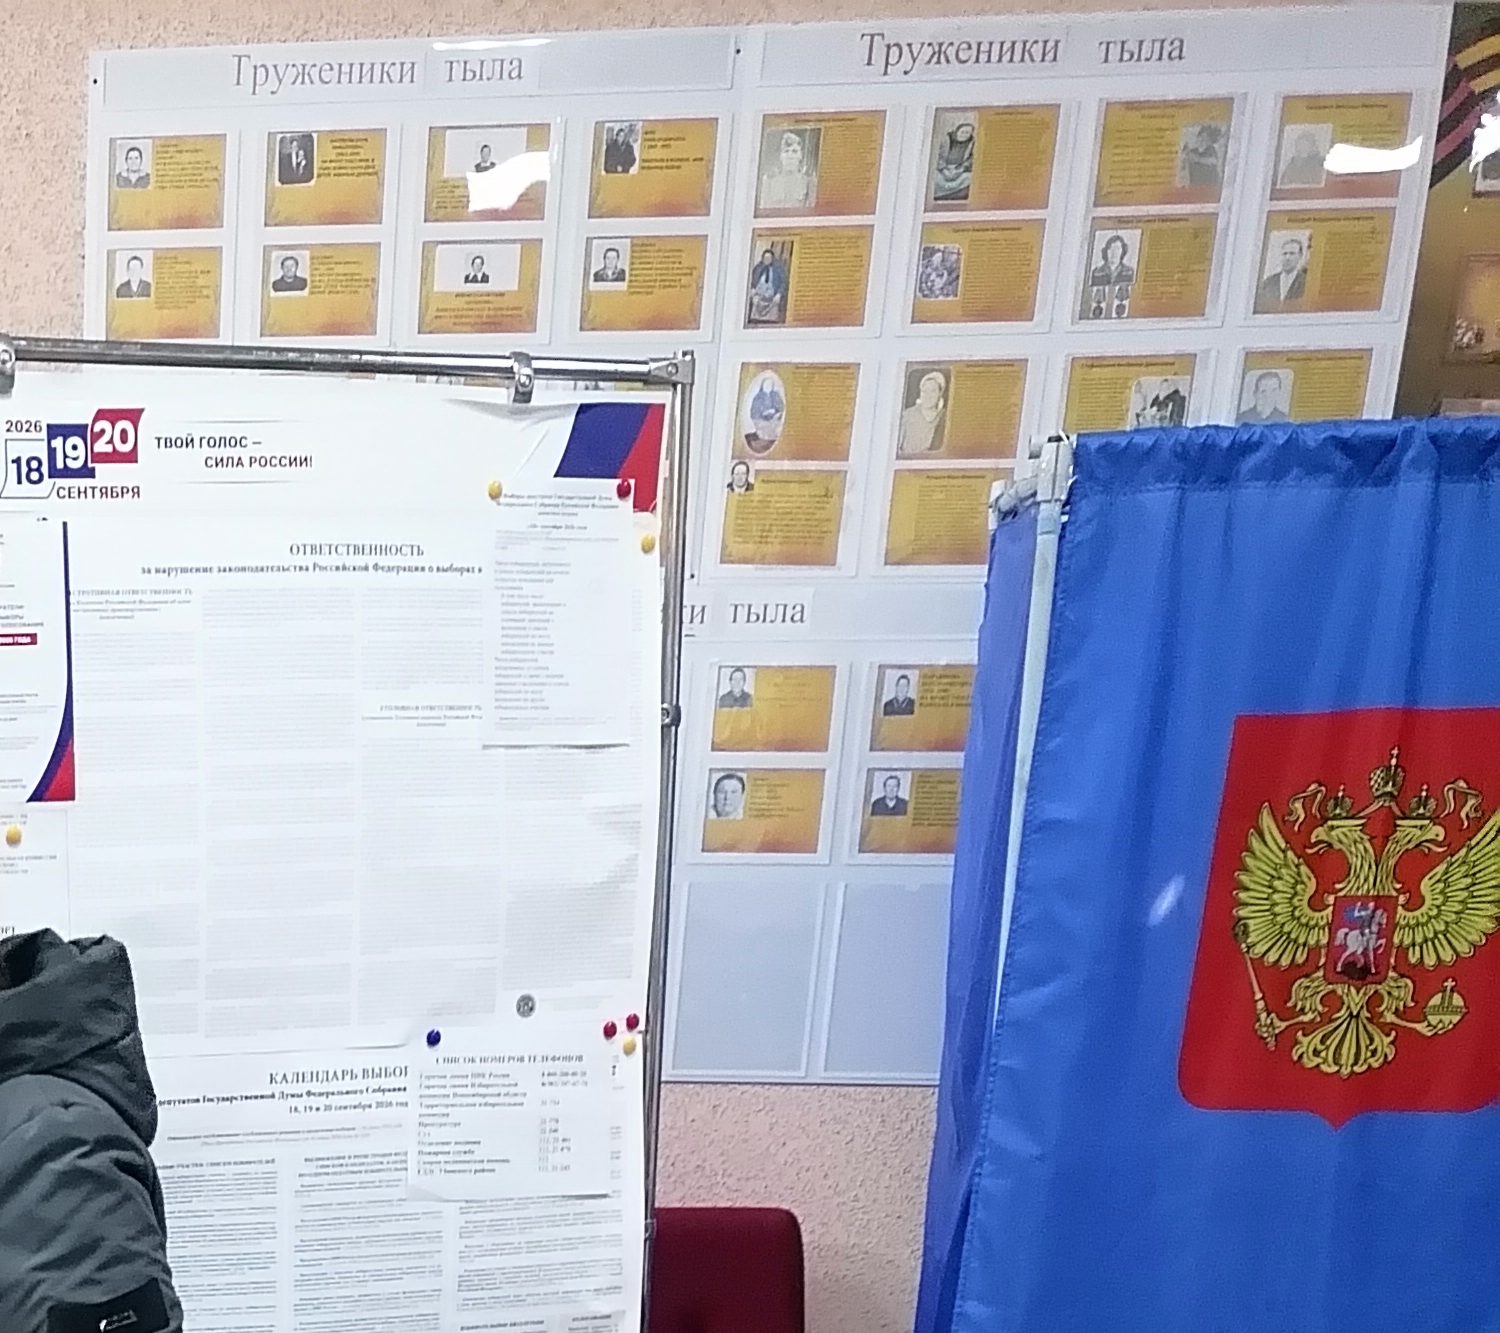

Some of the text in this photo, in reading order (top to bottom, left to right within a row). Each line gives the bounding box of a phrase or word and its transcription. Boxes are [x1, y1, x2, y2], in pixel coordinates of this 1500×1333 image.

[859, 30, 1187, 77] Труженики тыла
[231, 48, 524, 96] Труженики тыла
[5, 420, 42, 433] 2026
[93, 420, 136, 453] 20
[154, 434, 194, 449] ТВОЙ
[199, 435, 248, 449] ГОЛОС
[51, 436, 86, 469] 19
[204, 454, 313, 470] СИЛА РОССИИ!
[11, 456, 44, 485] 18
[56, 486, 141, 499] СЕНТЯБРЯ
[289, 543, 424, 558] ОТВЕТСТВЕННОСТЬ
[155, 564, 214, 578] нарушение
[216, 563, 310, 574] законодательства
[313, 561, 369, 573] Российской
[371, 563, 426, 576] Федерации
[729, 602, 807, 625] тыла
[269, 1067, 358, 1086] КАЛЕНДАРЬ
[202, 1090, 276, 1104] Государственной
[278, 1090, 304, 1101] Думы
[305, 1087, 364, 1099] Федерального
[365, 1084, 408, 1095] Собрания
